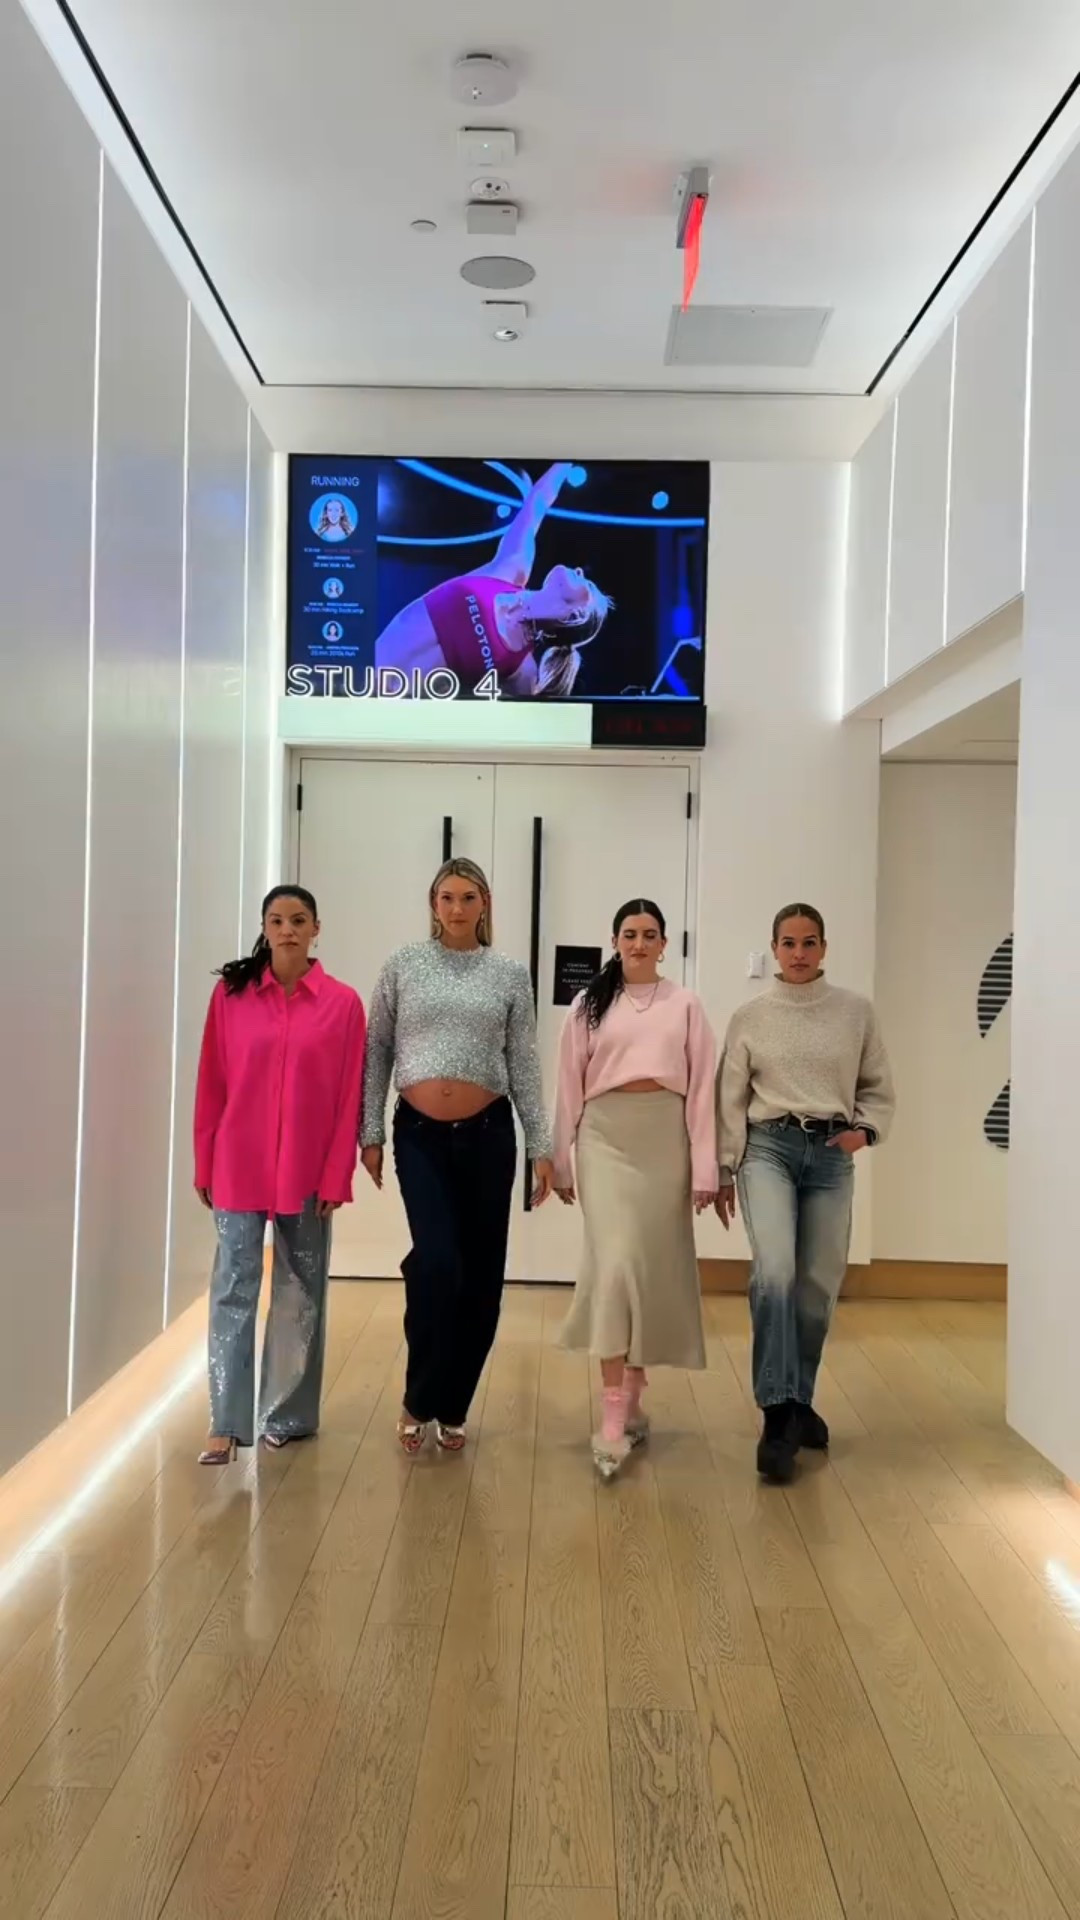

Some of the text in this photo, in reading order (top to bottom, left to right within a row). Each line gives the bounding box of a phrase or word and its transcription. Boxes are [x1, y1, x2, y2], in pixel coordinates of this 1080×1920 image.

[311, 475, 360, 487] RUNNING
[465, 594, 494, 670] PELOTON
[287, 663, 501, 701] STUDIO 4
